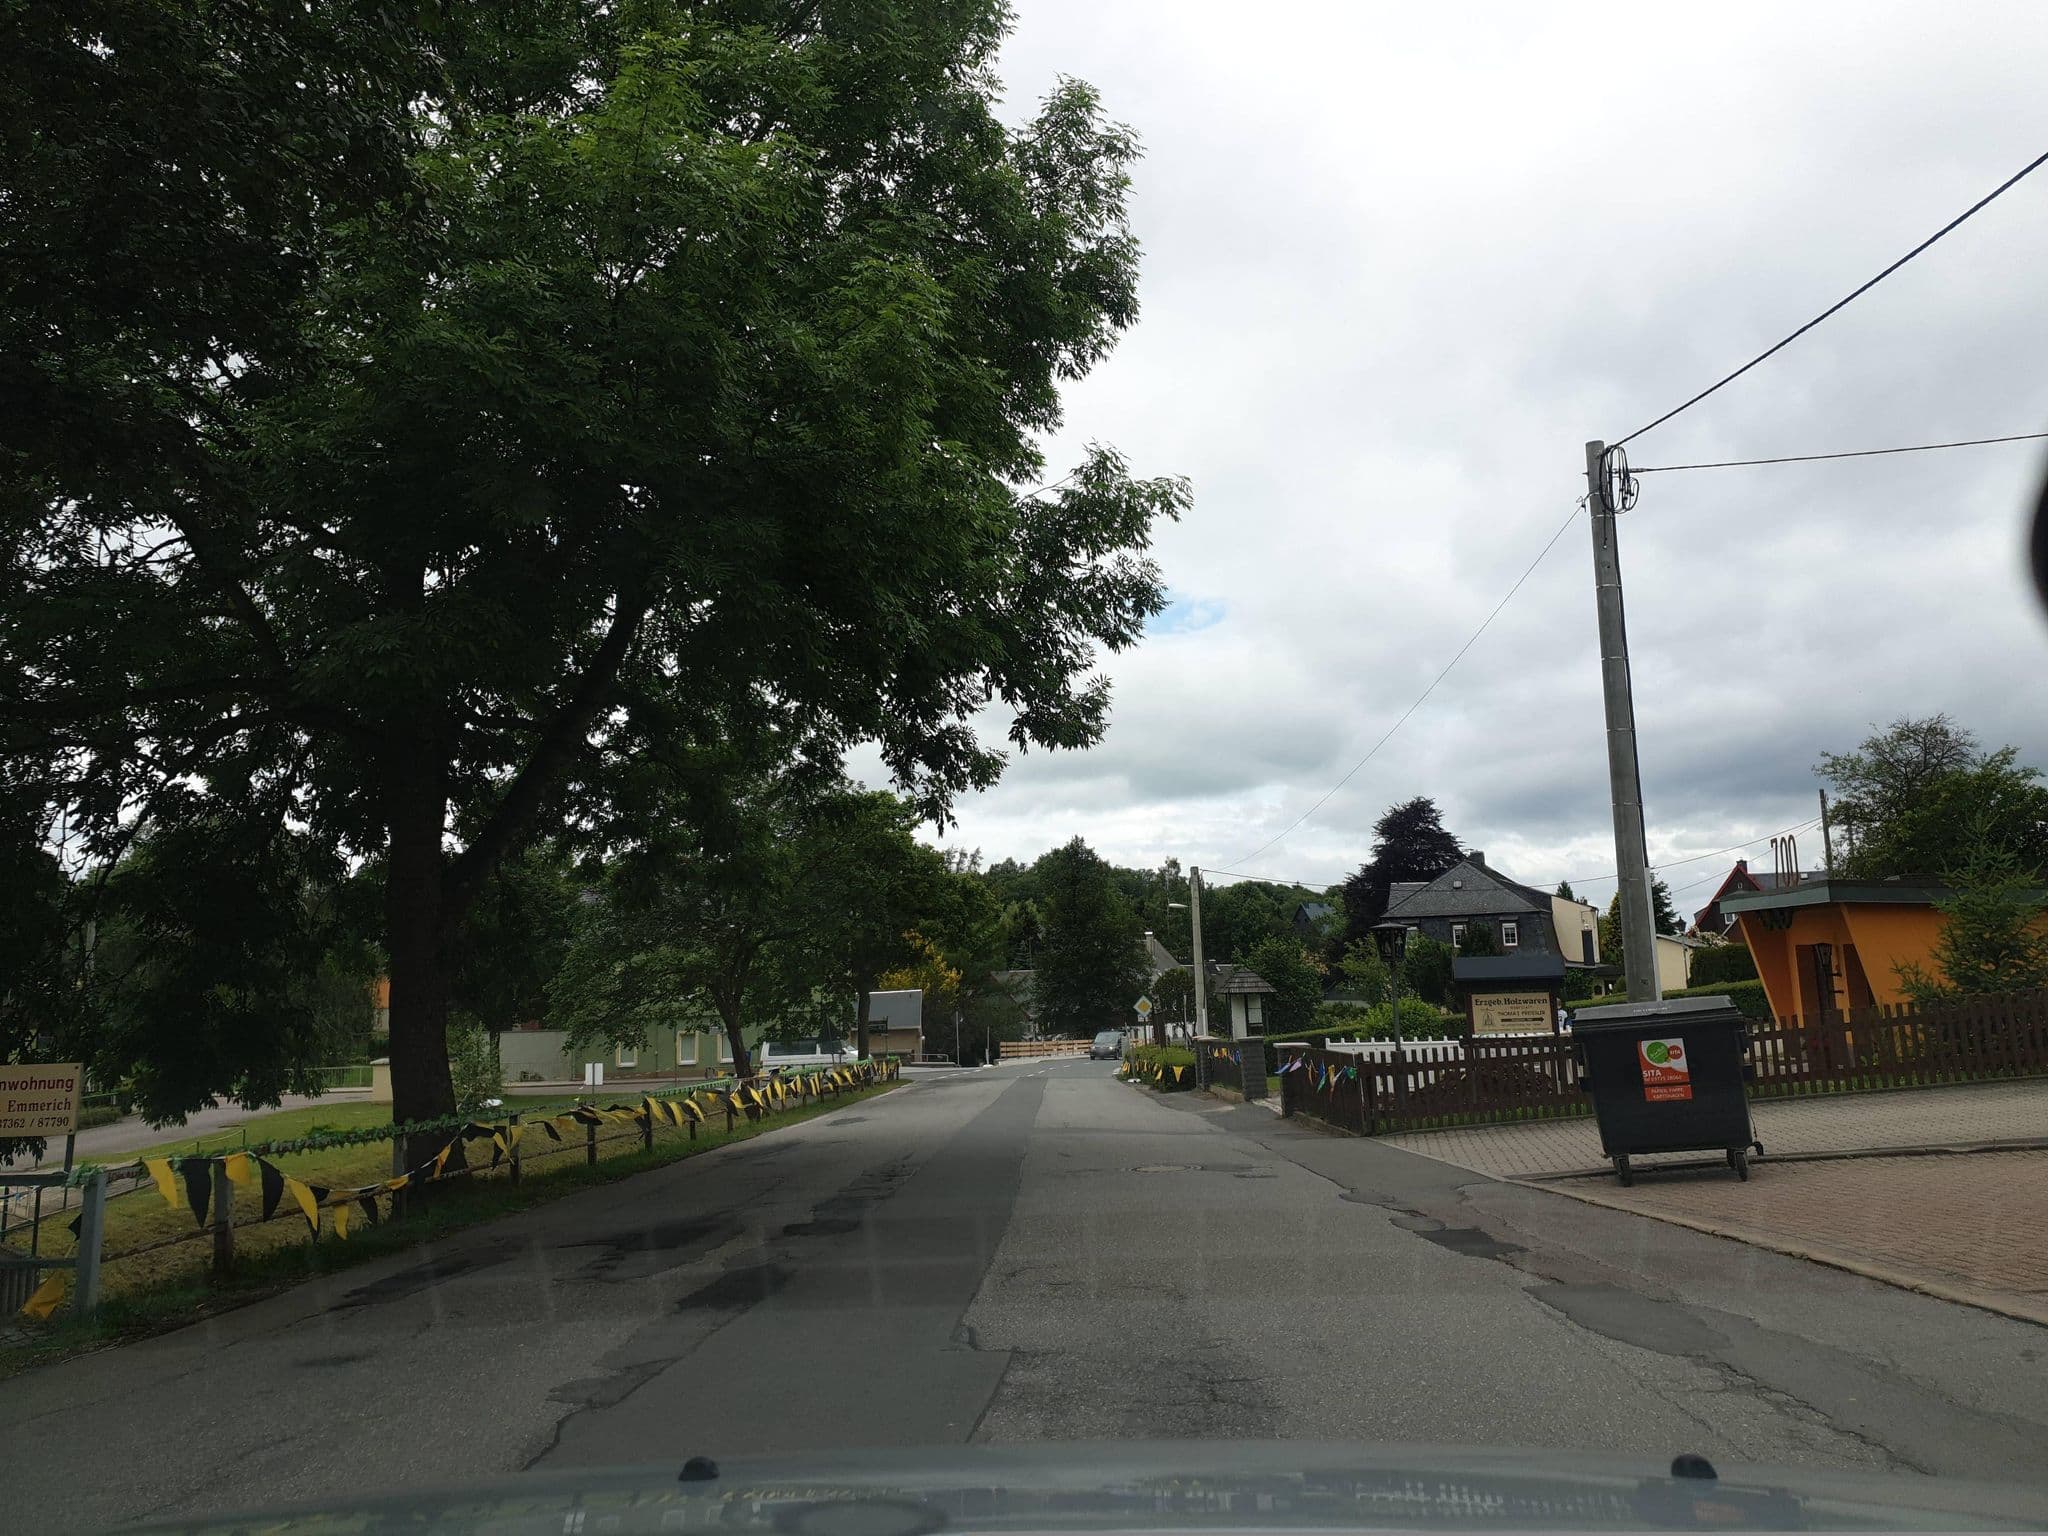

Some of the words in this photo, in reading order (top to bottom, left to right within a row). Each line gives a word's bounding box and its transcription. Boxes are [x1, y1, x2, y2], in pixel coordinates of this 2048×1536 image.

[1770, 835, 1799, 889] 700
[1475, 998, 1503, 1007] Erzgeb.
[1504, 997, 1548, 1005] Holzwaren
[1642, 1069, 1662, 1078] SITA
[8, 1098, 71, 1112] Emmerich
[37, 1116, 69, 1127] 87790
